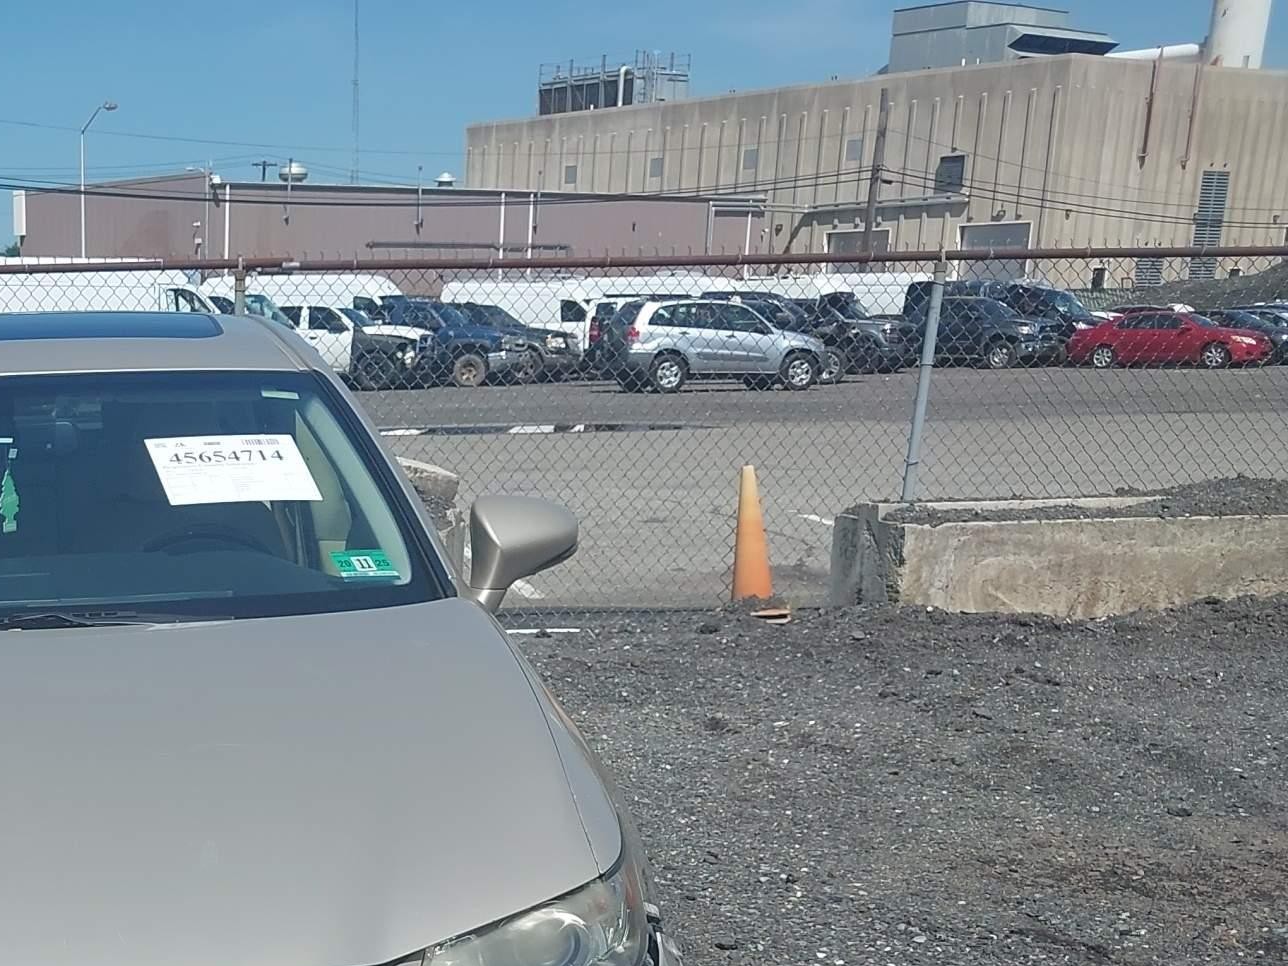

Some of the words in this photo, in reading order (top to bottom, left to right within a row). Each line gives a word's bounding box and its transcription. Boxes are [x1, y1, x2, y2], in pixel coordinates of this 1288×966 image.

[169, 449, 285, 465] 45654714
[338, 559, 352, 568] 20
[355, 557, 373, 569] 11
